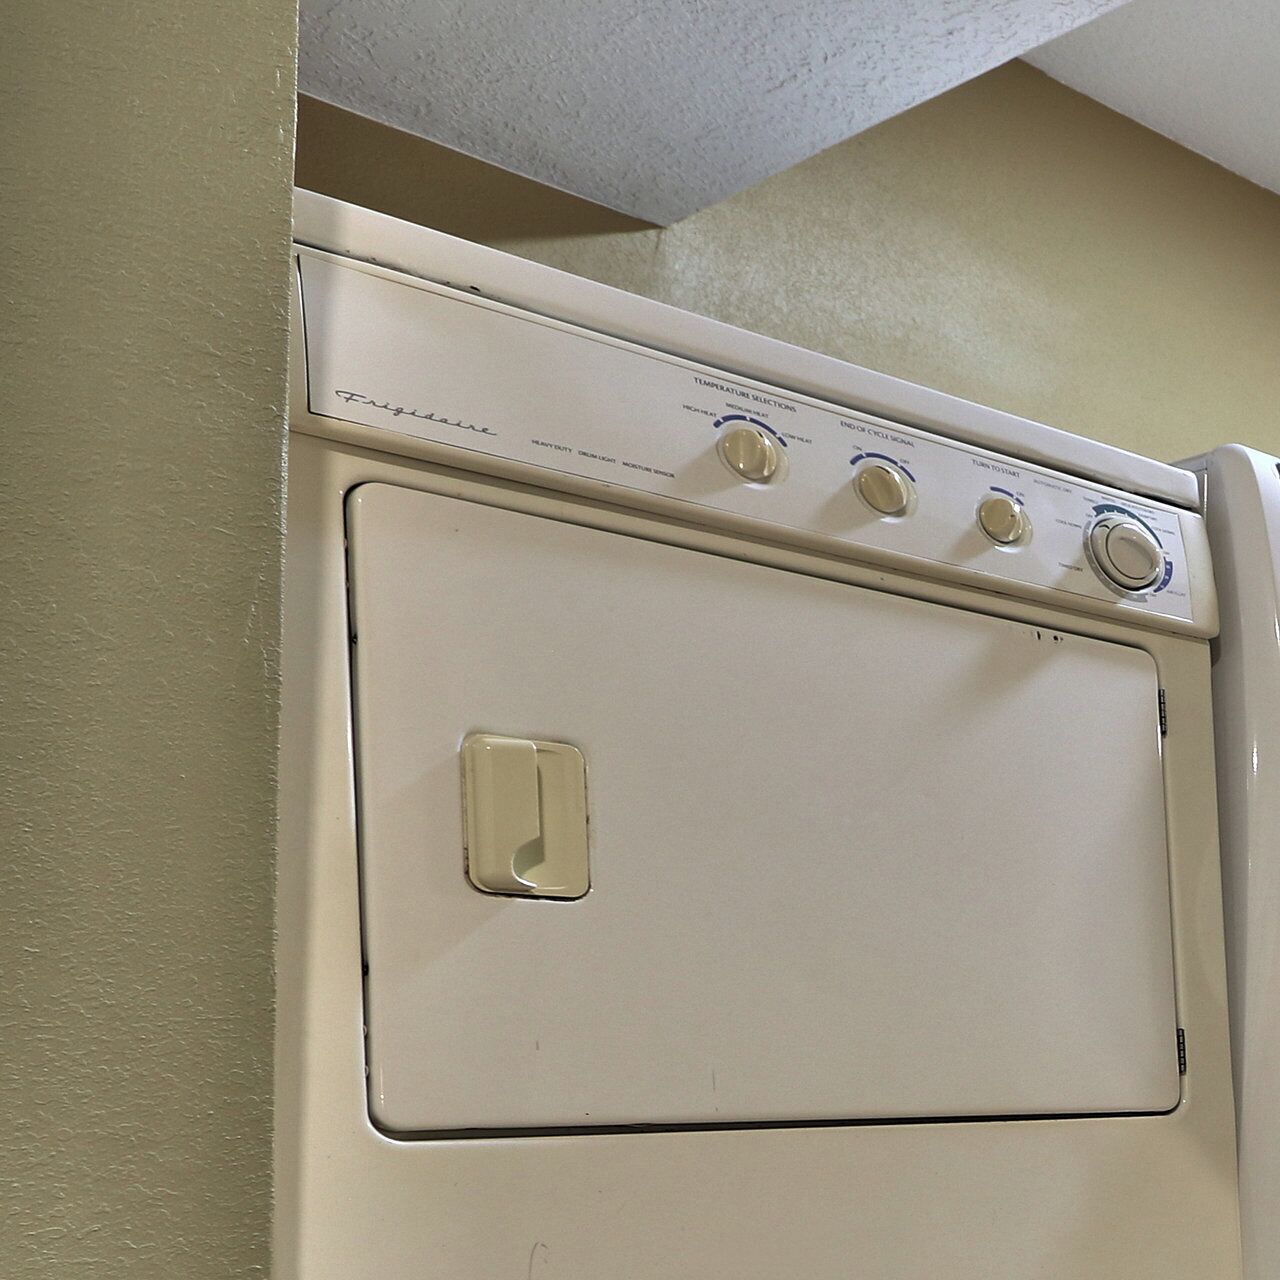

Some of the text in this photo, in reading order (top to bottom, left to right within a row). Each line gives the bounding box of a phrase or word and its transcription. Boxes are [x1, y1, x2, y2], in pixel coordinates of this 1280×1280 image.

[694, 377, 796, 412] TEMPERATURE SELECTIONS
[335, 390, 497, 436] Frigidaire
[840, 420, 915, 448] END OF CYCLE SIGNAL
[532, 439, 553, 448] HEAVY
[622, 462, 652, 473] MOISTURE
[653, 468, 675, 478] SENSOR
[972, 459, 1020, 478] TURN TO START
